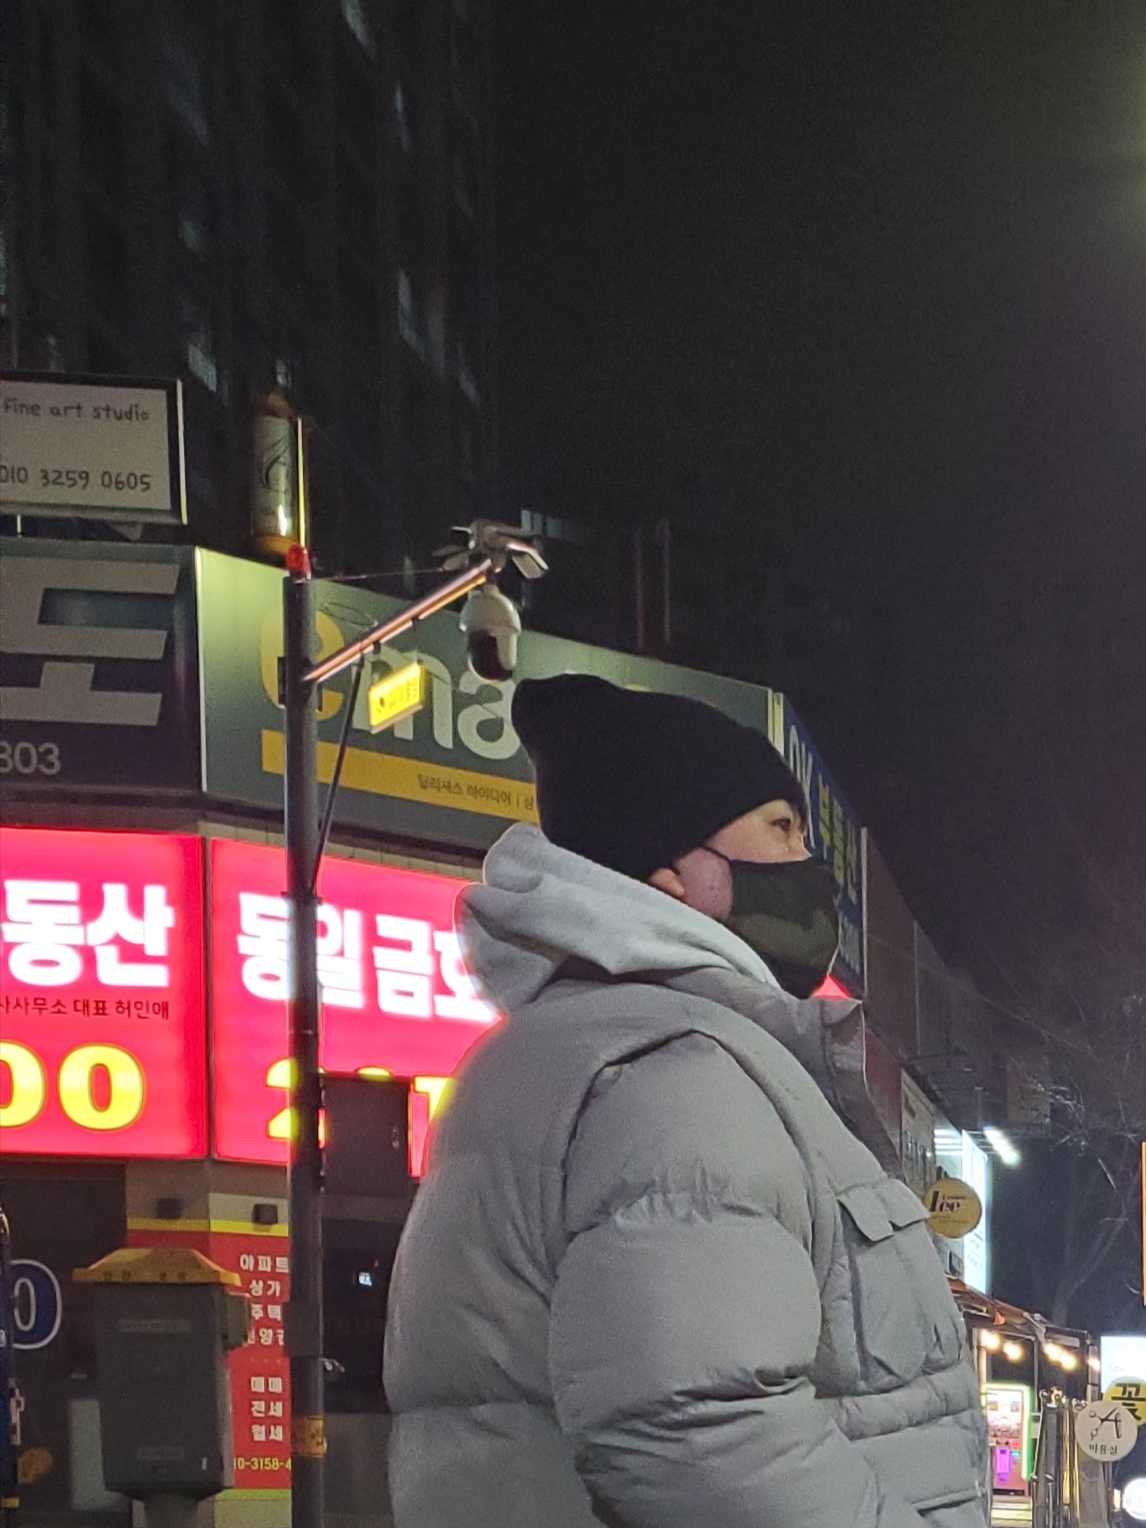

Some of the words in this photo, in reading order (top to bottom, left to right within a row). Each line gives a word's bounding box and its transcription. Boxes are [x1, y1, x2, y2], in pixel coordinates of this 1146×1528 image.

[3, 398, 41, 415] fine
[50, 402, 83, 418] art
[93, 404, 149, 421] studio
[0, 465, 28, 484] 010
[40, 469, 90, 488] 3259
[101, 471, 152, 491] 0605
[73, 998, 109, 1018] 대표
[115, 999, 169, 1020] 허인애
[240, 1254, 289, 1273] 아파트
[249, 1279, 281, 1297] 상가
[251, 1401, 283, 1418] 전세
[1110, 1382, 1146, 1421] 꽃
[251, 1424, 283, 1442] 월세
[1088, 1443, 1118, 1456] 미용실
